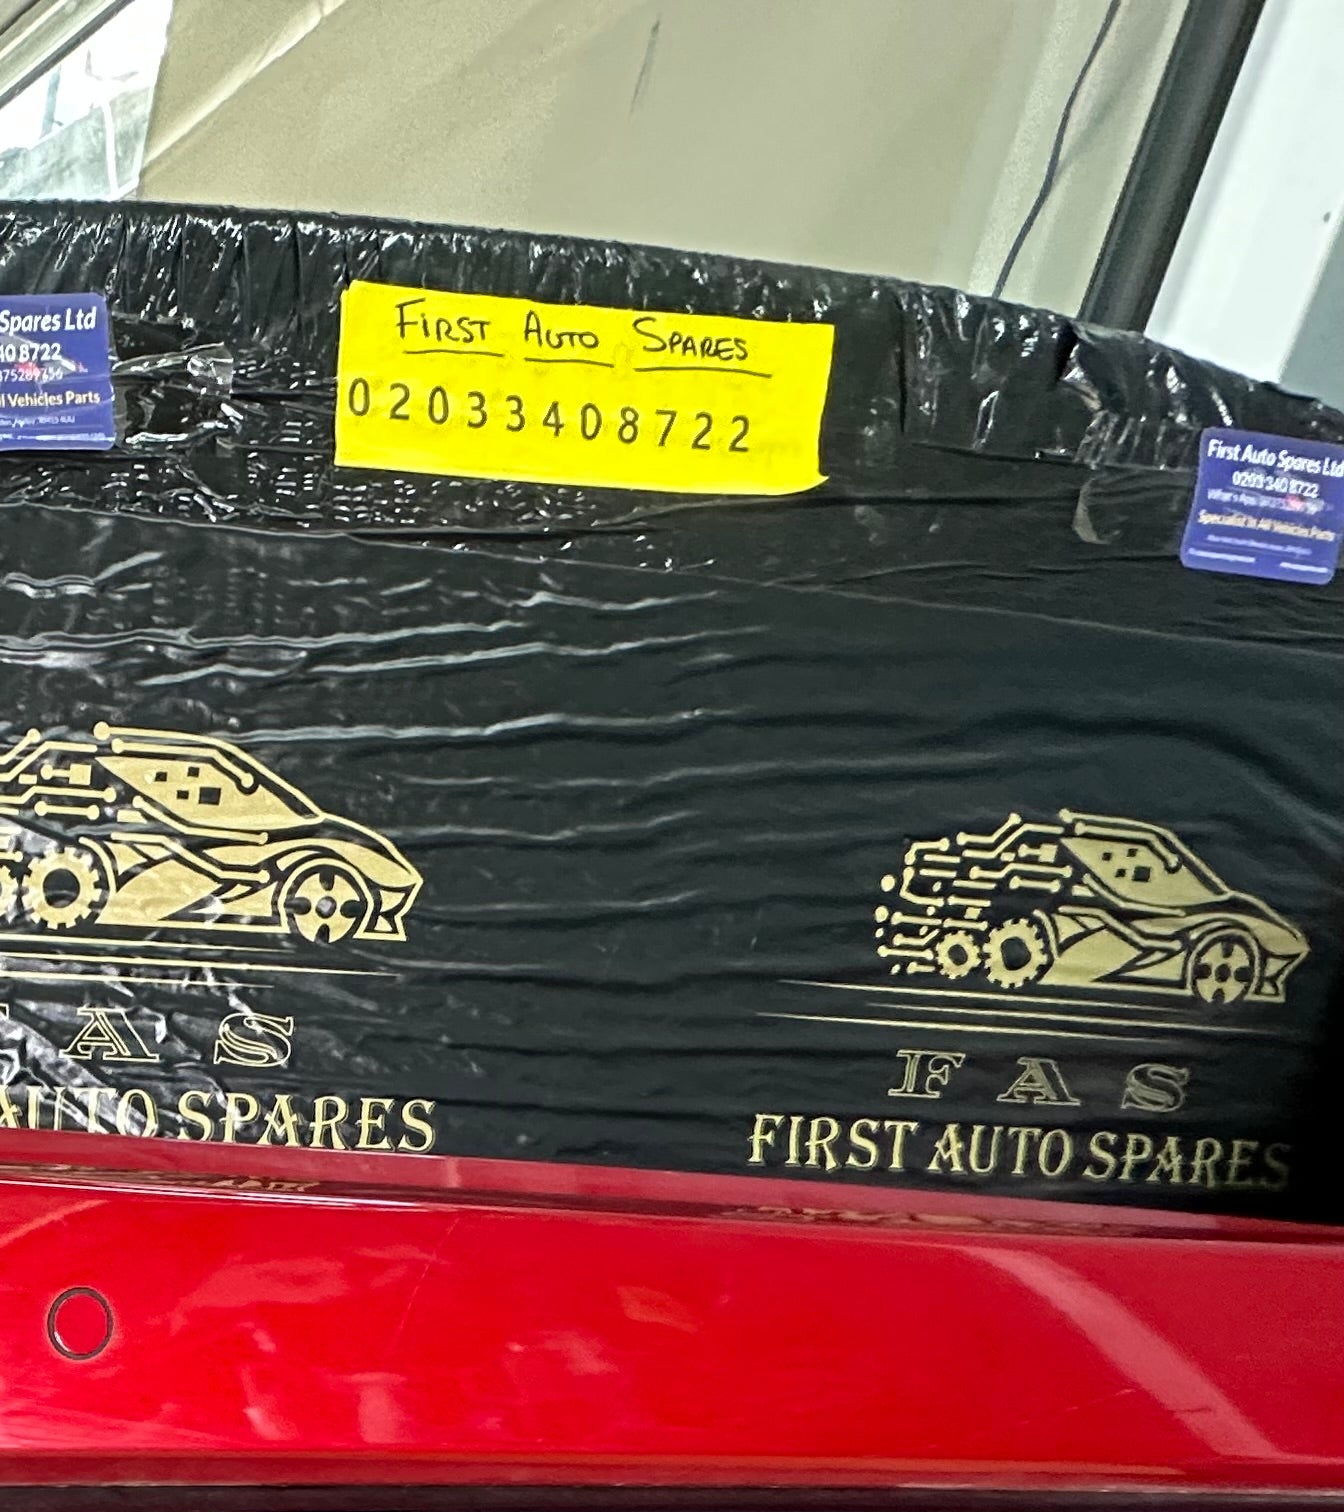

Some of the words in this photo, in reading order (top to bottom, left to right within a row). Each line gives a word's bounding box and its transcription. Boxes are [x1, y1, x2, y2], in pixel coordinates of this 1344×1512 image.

[64, 306, 97, 331] Ltd
[523, 310, 600, 350] AUTO
[632, 316, 750, 362] SPARES
[19, 342, 63, 362] 8722
[7, 392, 63, 408] Vehicles
[65, 390, 101, 405] Parts
[348, 376, 751, 454] 02033408722
[1207, 438, 1241, 461] First
[1241, 444, 1277, 466] Auto
[1276, 449, 1321, 474] Spares
[1322, 457, 1344, 478] Ltd
[177, 1088, 438, 1153] SPARES
[746, 1113, 920, 1173] FIRST
[927, 1122, 1075, 1178] AUTO
[1082, 1130, 1292, 1192] SPARES
